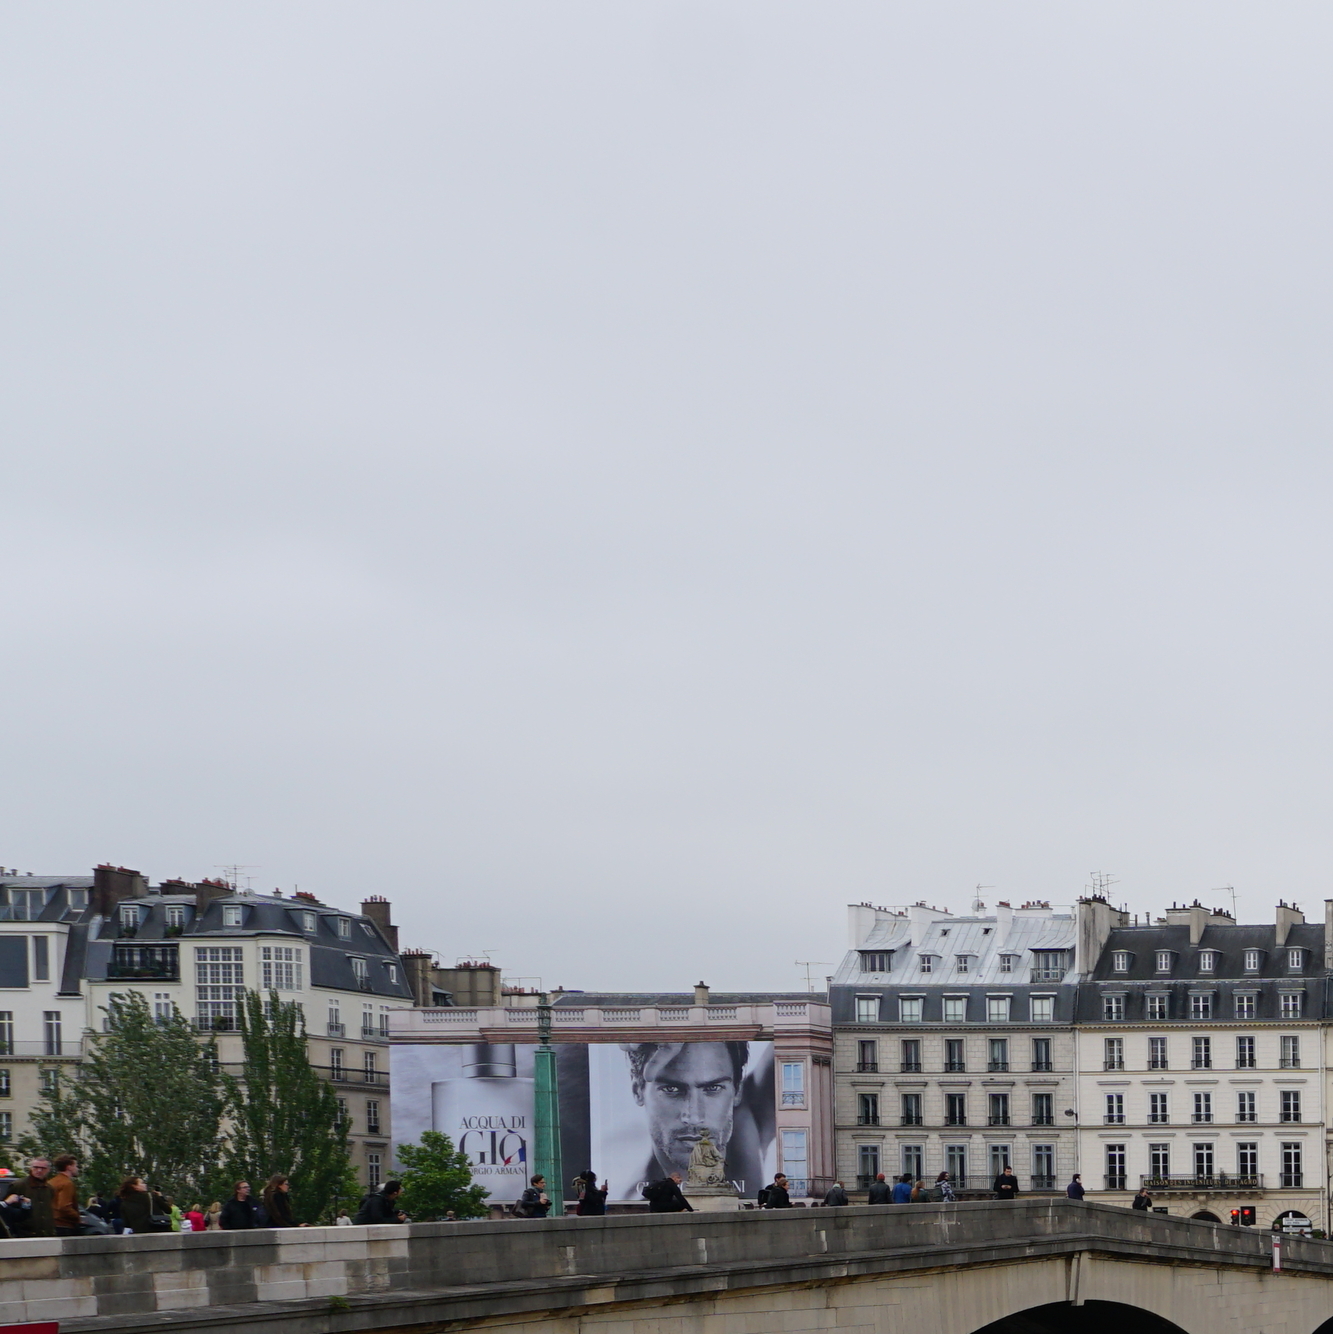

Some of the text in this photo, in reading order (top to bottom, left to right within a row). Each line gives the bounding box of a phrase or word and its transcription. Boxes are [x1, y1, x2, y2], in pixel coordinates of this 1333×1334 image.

[459, 1115, 526, 1129] ACQUA DI
[459, 1129, 526, 1166] GIÒ
[494, 1167, 525, 1175] ARMAN
